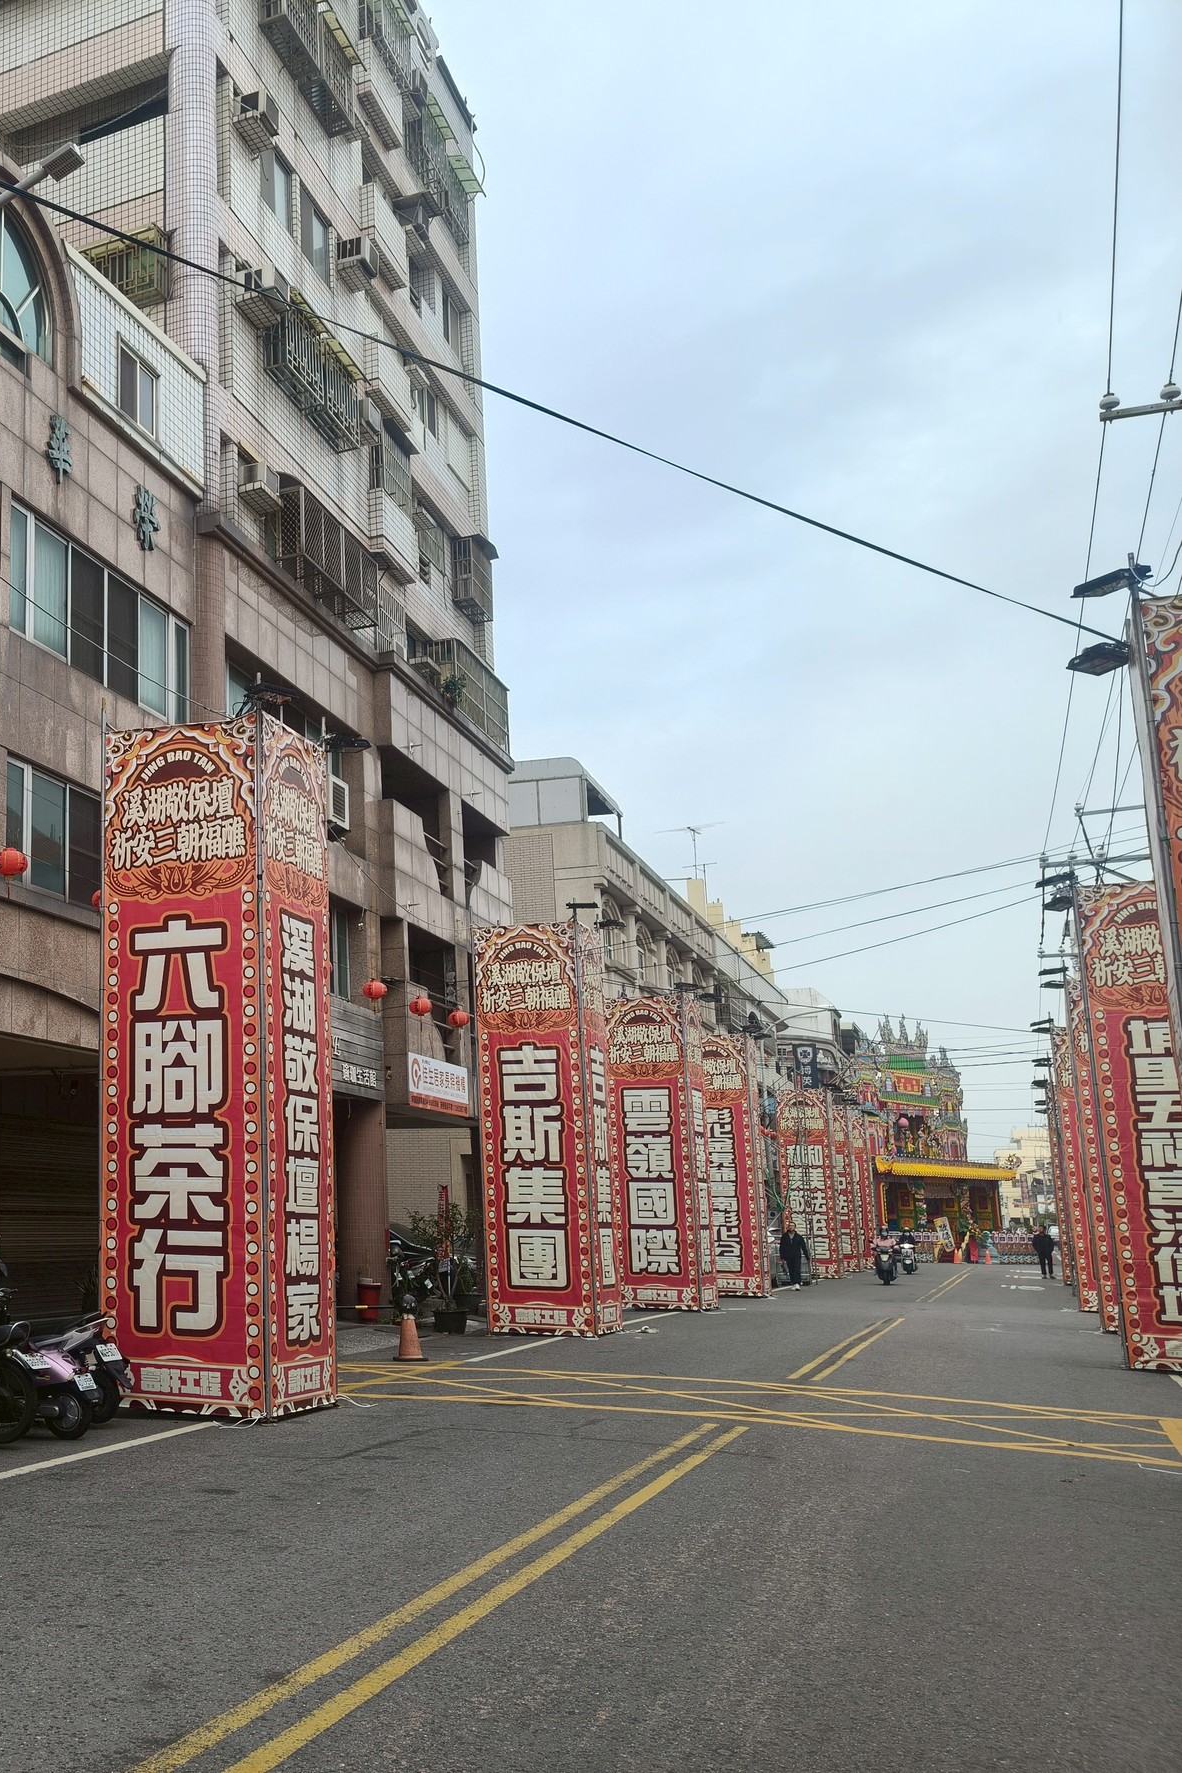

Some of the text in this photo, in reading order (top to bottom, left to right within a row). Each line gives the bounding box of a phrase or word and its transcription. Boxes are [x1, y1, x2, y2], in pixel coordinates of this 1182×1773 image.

[140, 750, 215, 782] JING BAO TAN
[122, 775, 235, 829] 溪湖敬保壇
[110, 817, 246, 871] 祈安三朝福醮
[1115, 905, 1137, 924] JING
[481, 983, 571, 1014] 祈安三朝福醮
[487, 959, 563, 987] 溪湖敬保壇
[133, 919, 224, 1331] 六腳茶行
[282, 913, 320, 1343] 溪湖敬保壇楊家
[500, 1044, 568, 1287] 吉斯集團
[589, 1045, 615, 1287] 吉斯集團
[623, 1089, 680, 1273] 雲嶺國際
